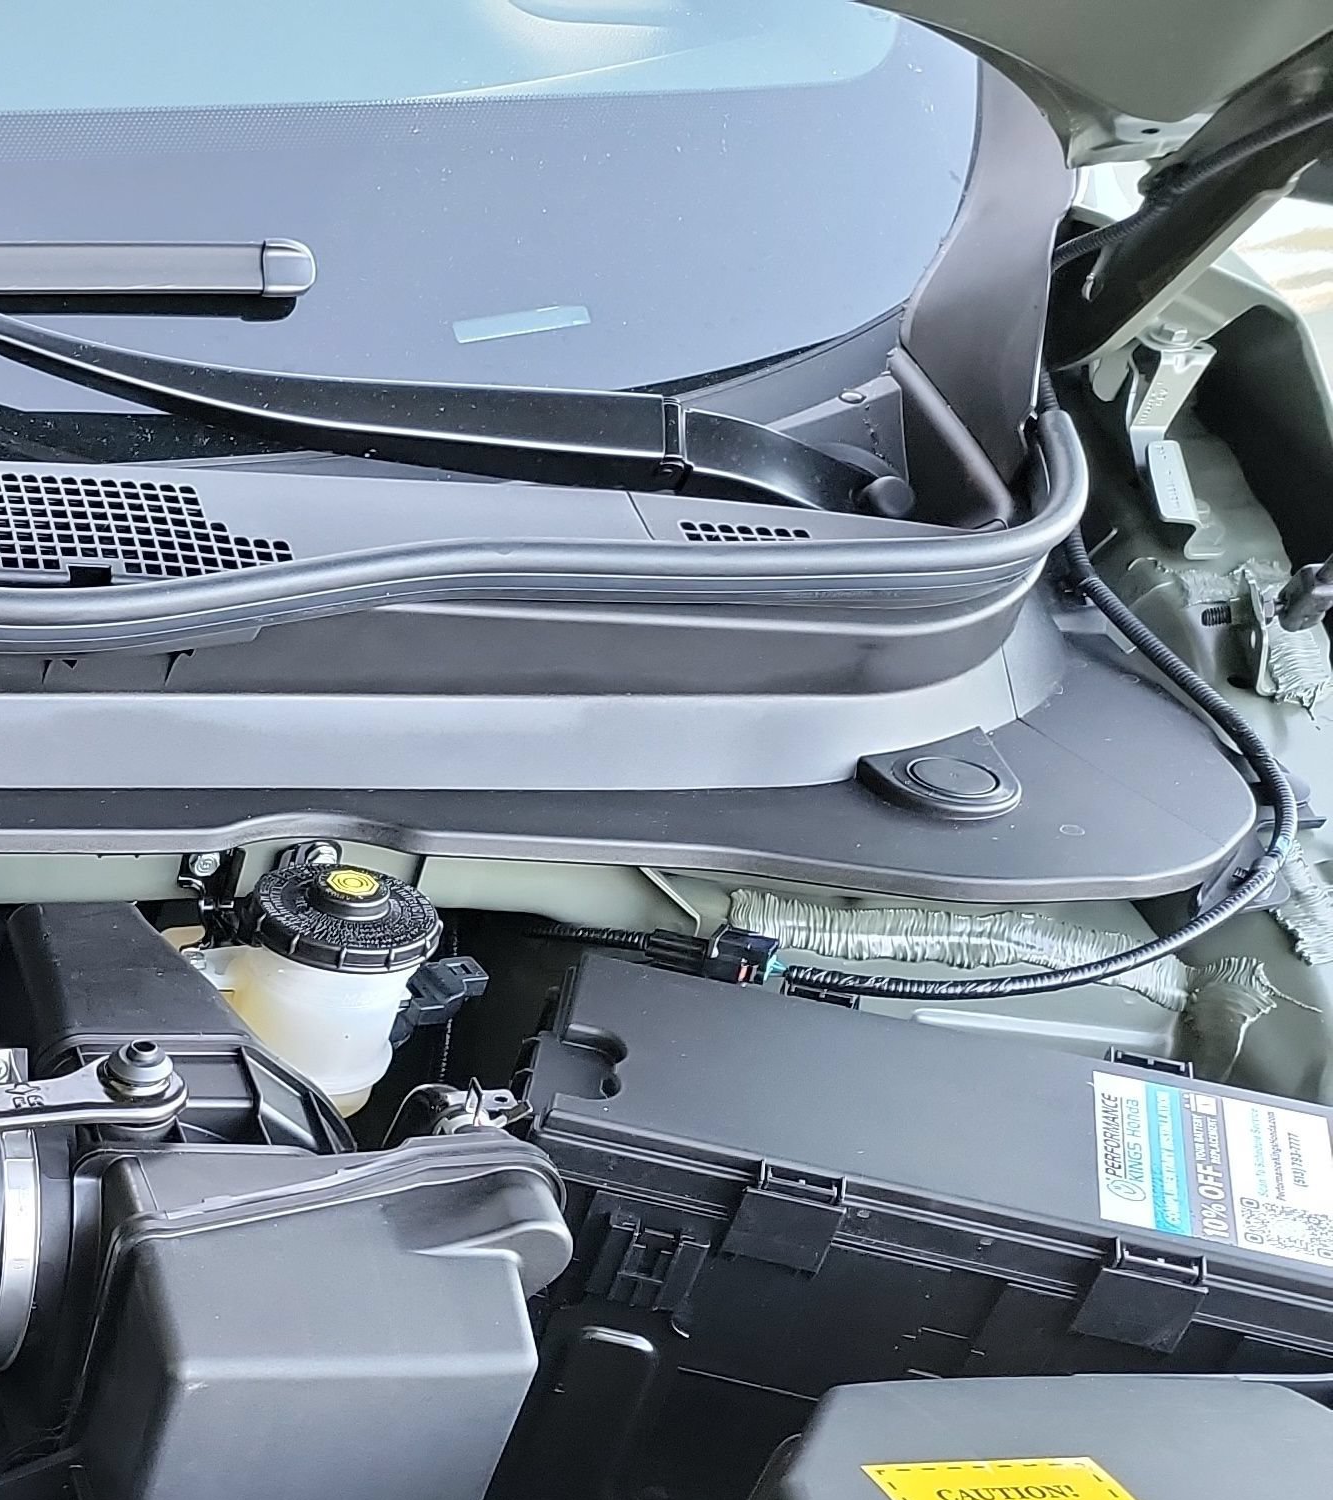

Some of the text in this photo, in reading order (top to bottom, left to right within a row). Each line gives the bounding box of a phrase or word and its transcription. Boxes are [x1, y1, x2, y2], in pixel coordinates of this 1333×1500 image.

[1101, 1093, 1123, 1178] PERFORMANCE
[1125, 1098, 1144, 1183] KINGS Honda
[1287, 1133, 1309, 1188] (513) 793-7777
[1196, 1163, 1230, 1238] 10% OFF
